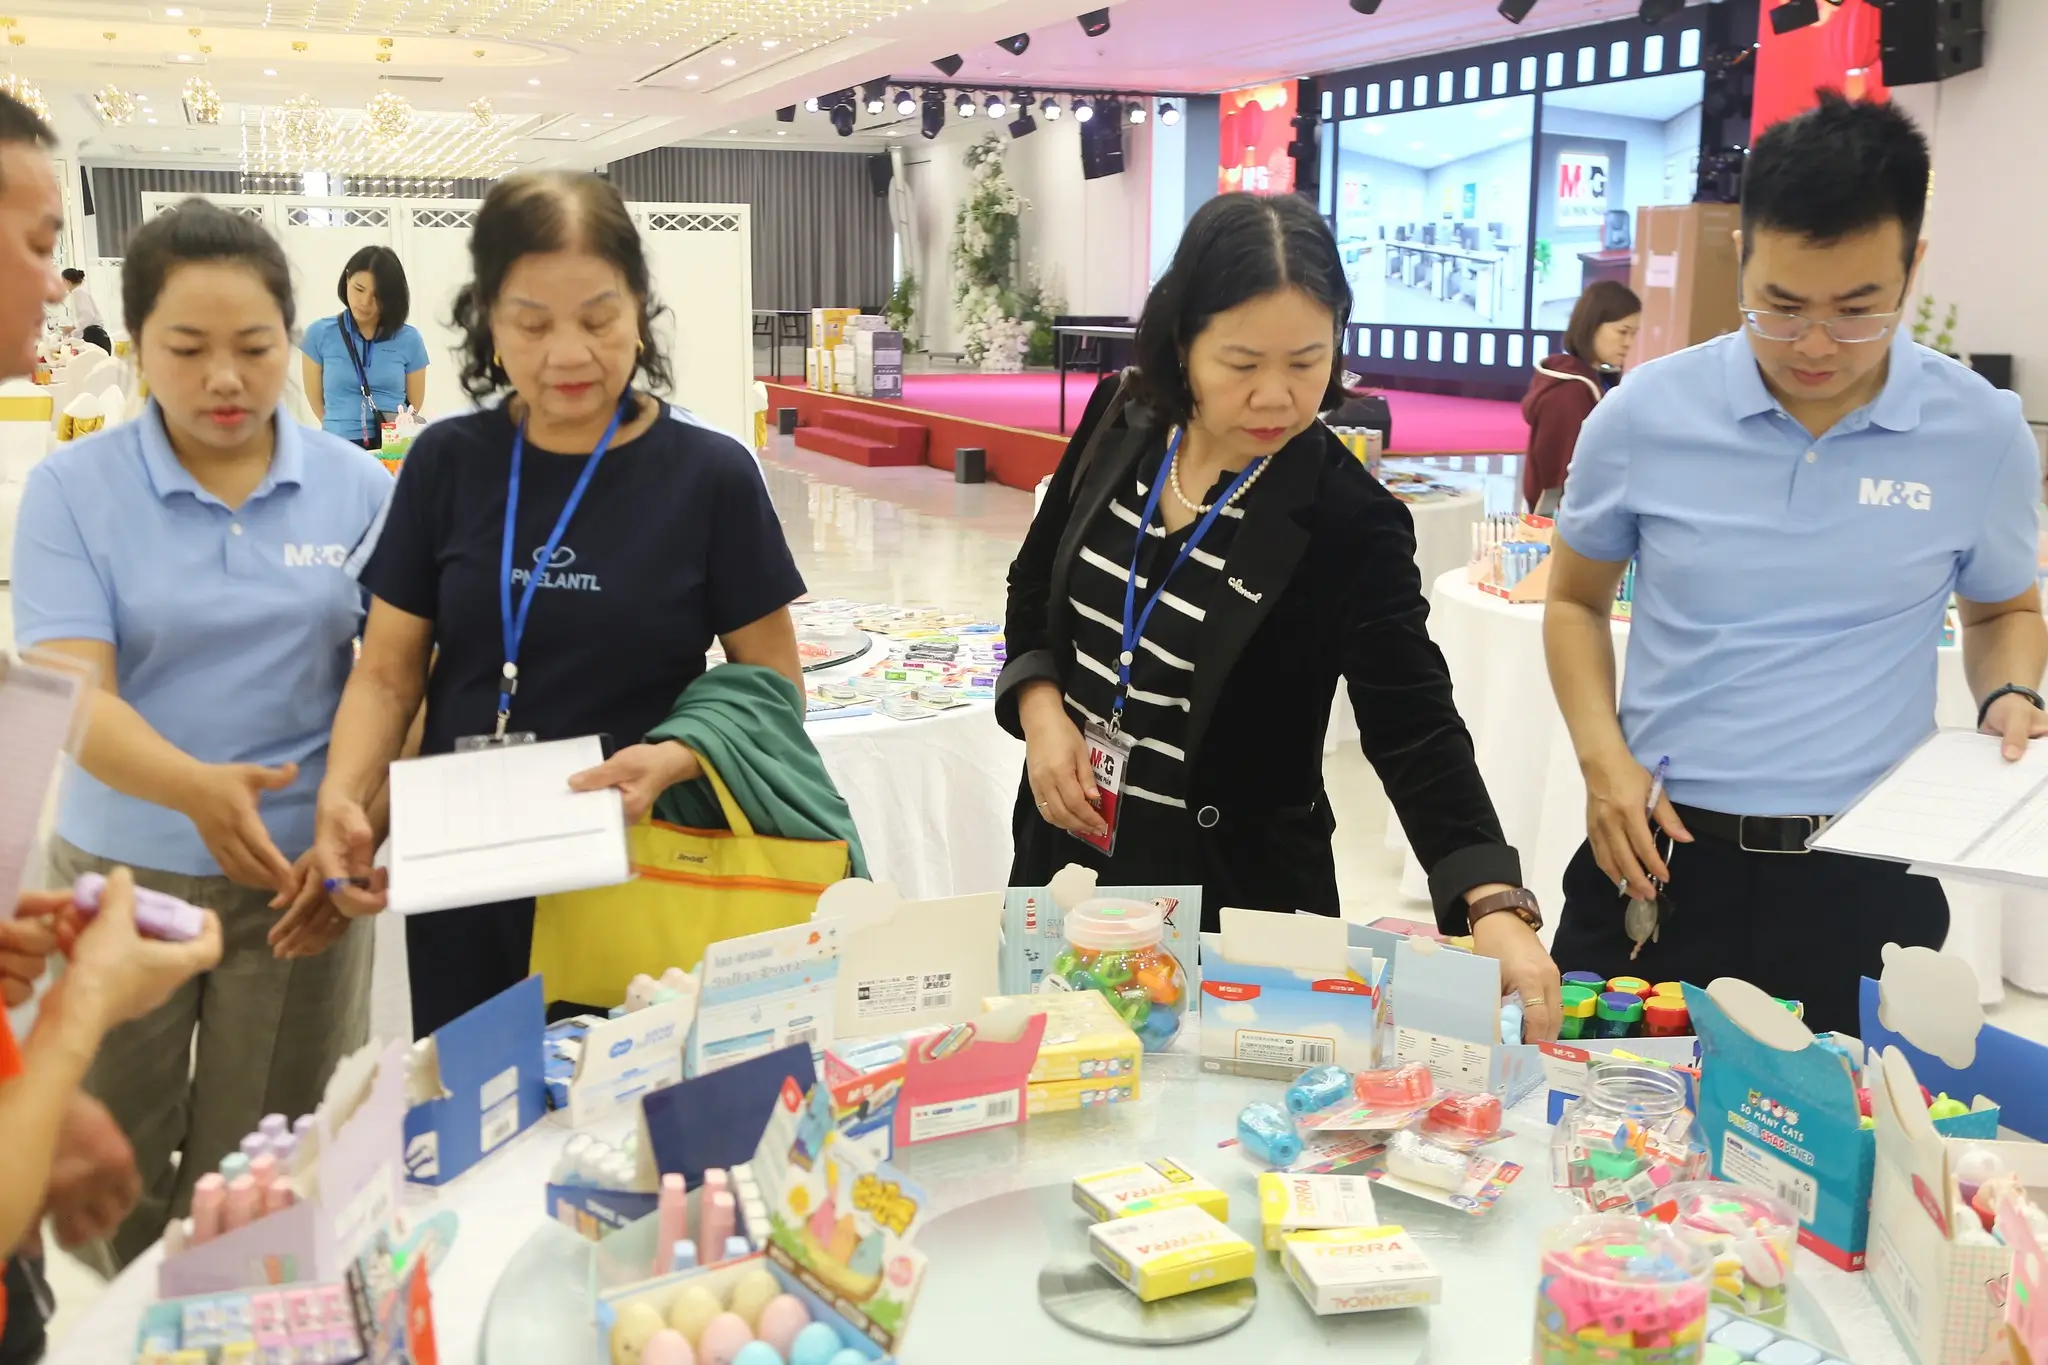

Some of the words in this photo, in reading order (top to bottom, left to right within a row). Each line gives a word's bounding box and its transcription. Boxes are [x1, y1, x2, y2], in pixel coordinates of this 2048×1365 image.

[1859, 477, 1932, 511] M&G
[283, 543, 348, 568] M&G
[1090, 746, 1115, 777] M&G
[1740, 1103, 1752, 1115] SO
[1753, 1111, 1779, 1128] MANY
[1781, 1125, 1804, 1142] CATS
[1313, 1241, 1403, 1257] TERRA
